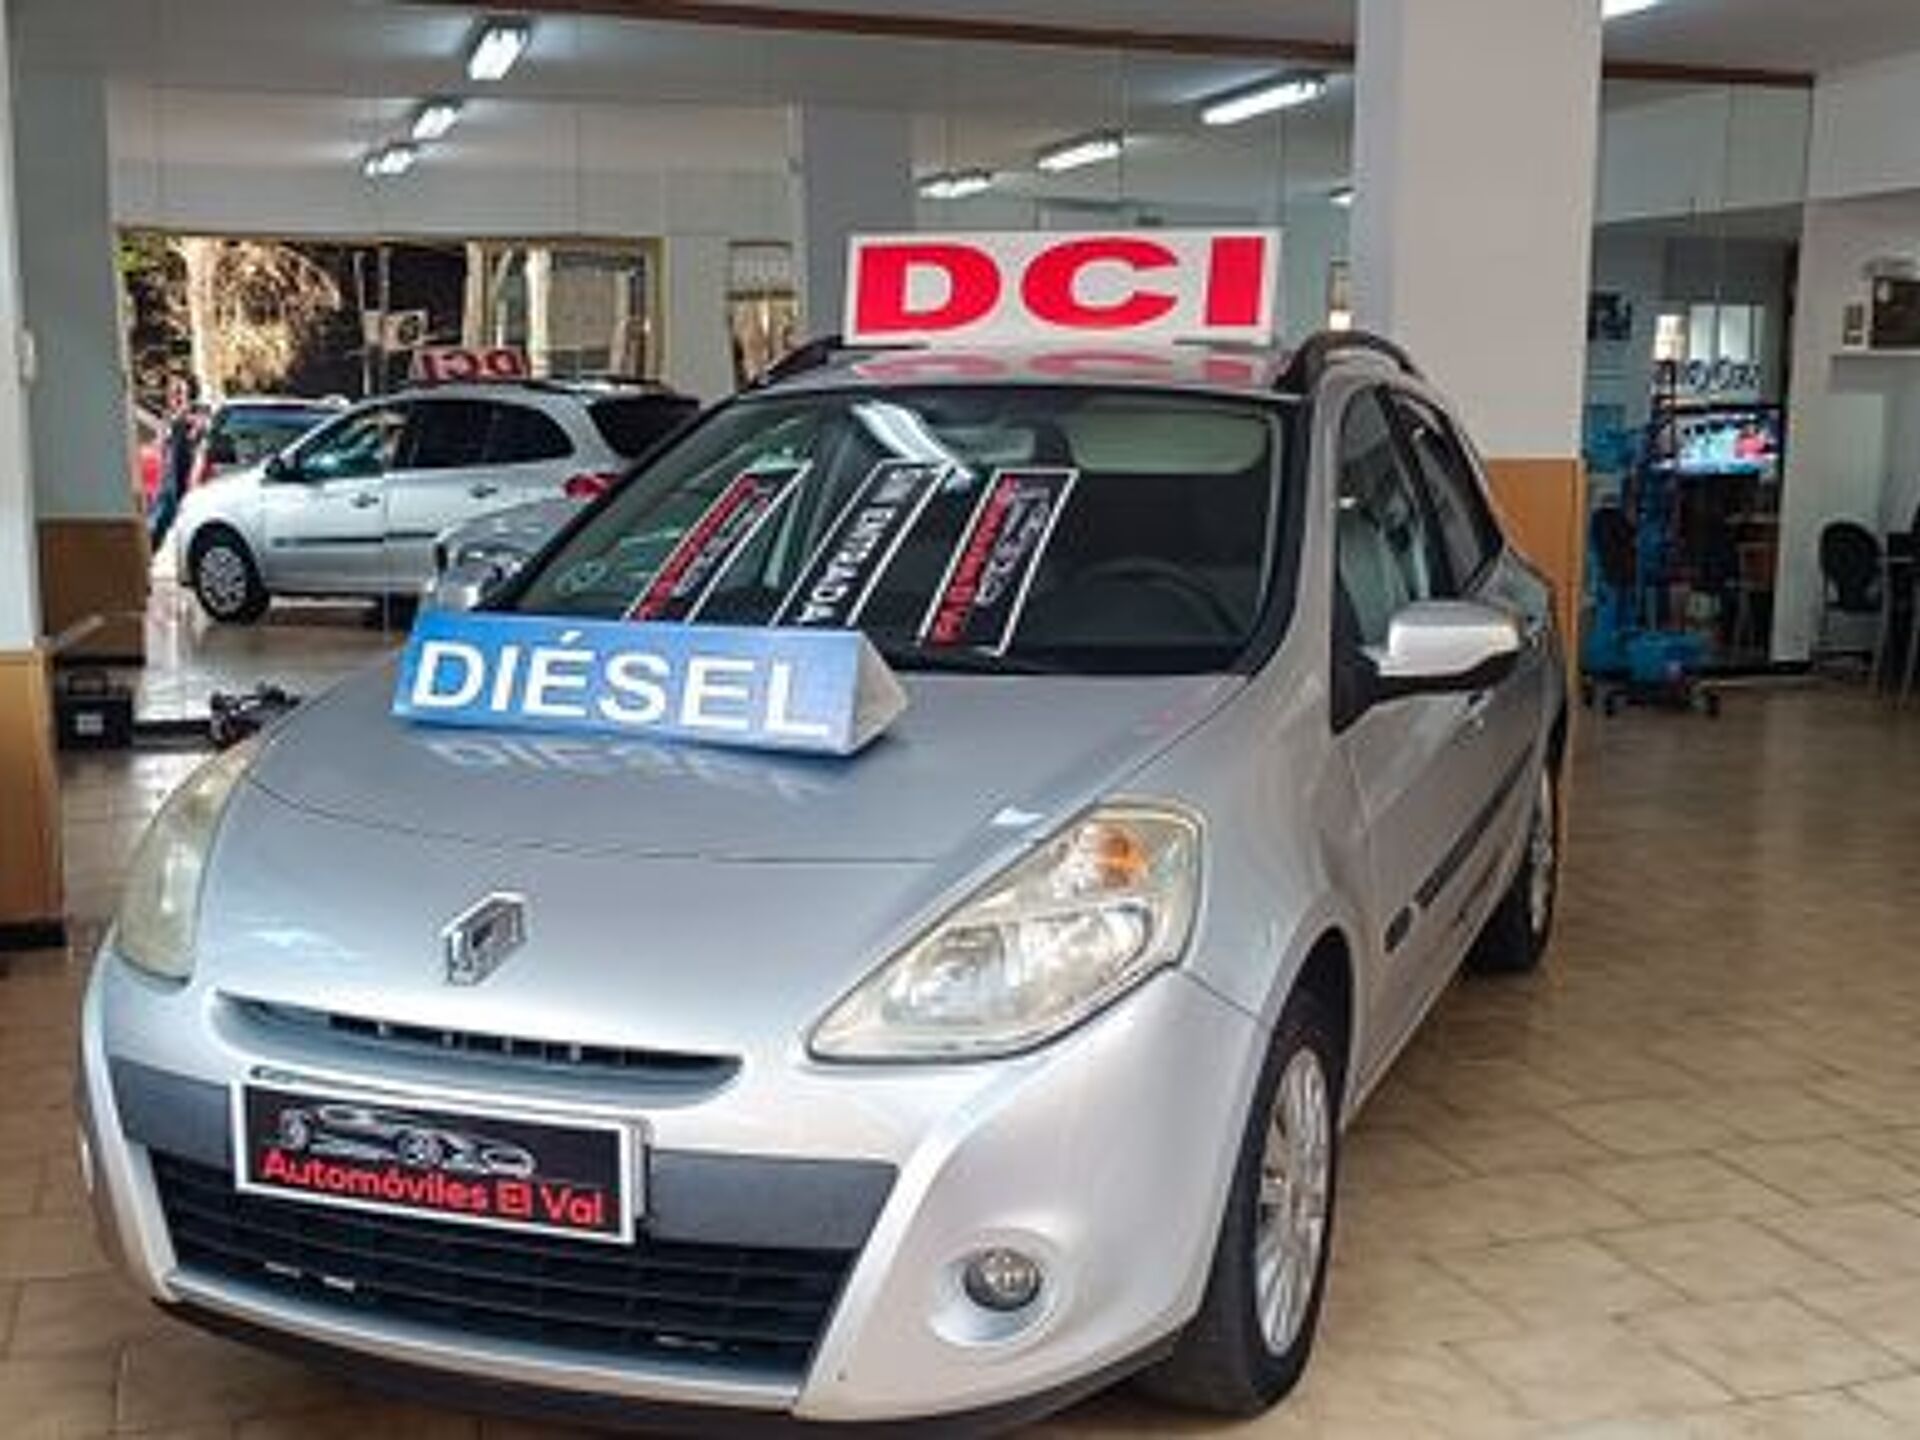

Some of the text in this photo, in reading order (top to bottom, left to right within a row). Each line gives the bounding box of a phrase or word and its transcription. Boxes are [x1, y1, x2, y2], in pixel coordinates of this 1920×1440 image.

[855, 236, 1267, 334] DCI
[412, 630, 829, 736] DIÉSEL
[263, 1150, 605, 1224] Automóviles El Val
